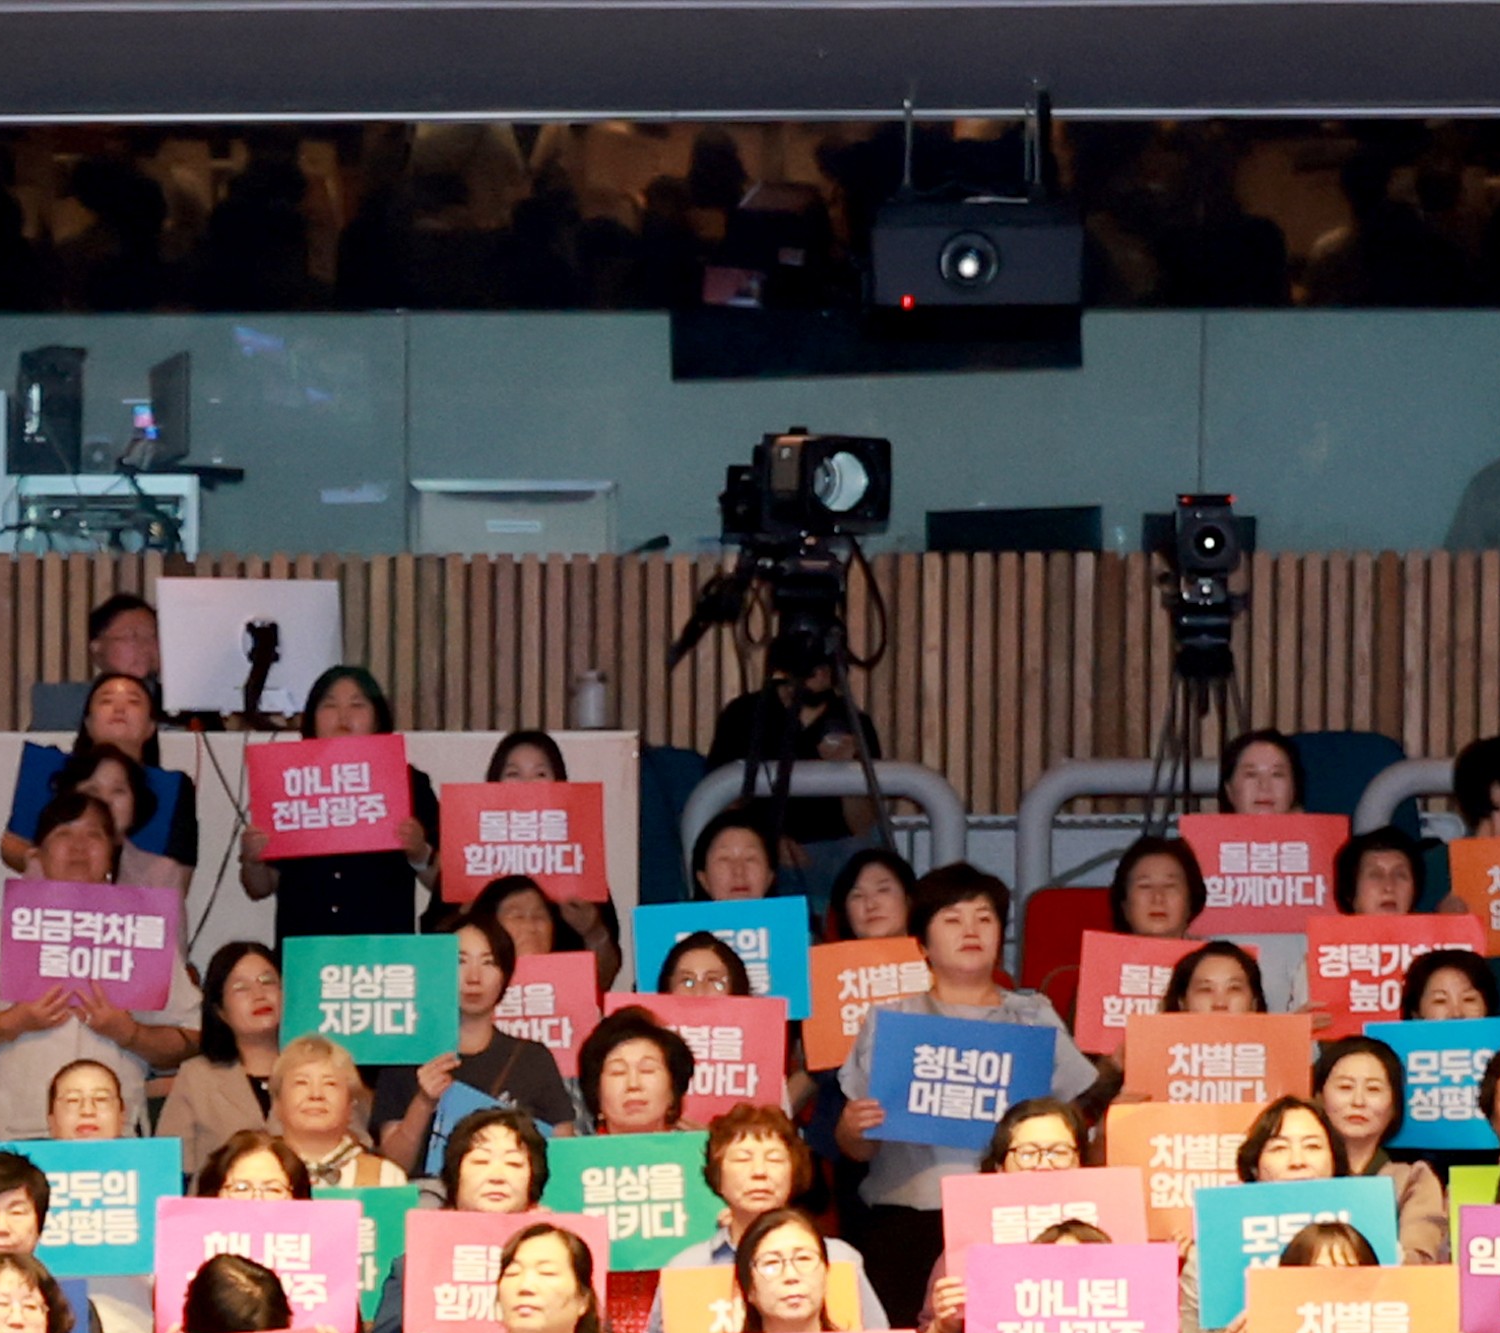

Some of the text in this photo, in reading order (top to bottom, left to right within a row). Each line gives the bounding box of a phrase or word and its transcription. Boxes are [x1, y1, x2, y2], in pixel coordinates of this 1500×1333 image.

[284, 763, 369, 795] 하나된
[274, 793, 386, 830] 전남광주
[481, 811, 566, 841] 돌봄을
[465, 844, 583, 875] 함께하다
[1221, 843, 1308, 873] 돌봄을
[1204, 876, 1325, 906] 함께하다
[12, 908, 164, 949] 임금격차를
[40, 946, 133, 981] 줄이다
[321, 965, 415, 998] 일상을
[839, 967, 930, 1000] 차별을
[319, 1000, 418, 1035] 지키다
[914, 1045, 1011, 1084] 청년이
[1169, 1044, 1265, 1076] 차별을
[909, 1083, 1008, 1122] 머물다
[581, 1163, 685, 1200] 일상을
[37, 1208, 140, 1246] 성평등
[1015, 1279, 1128, 1317] 하나된
